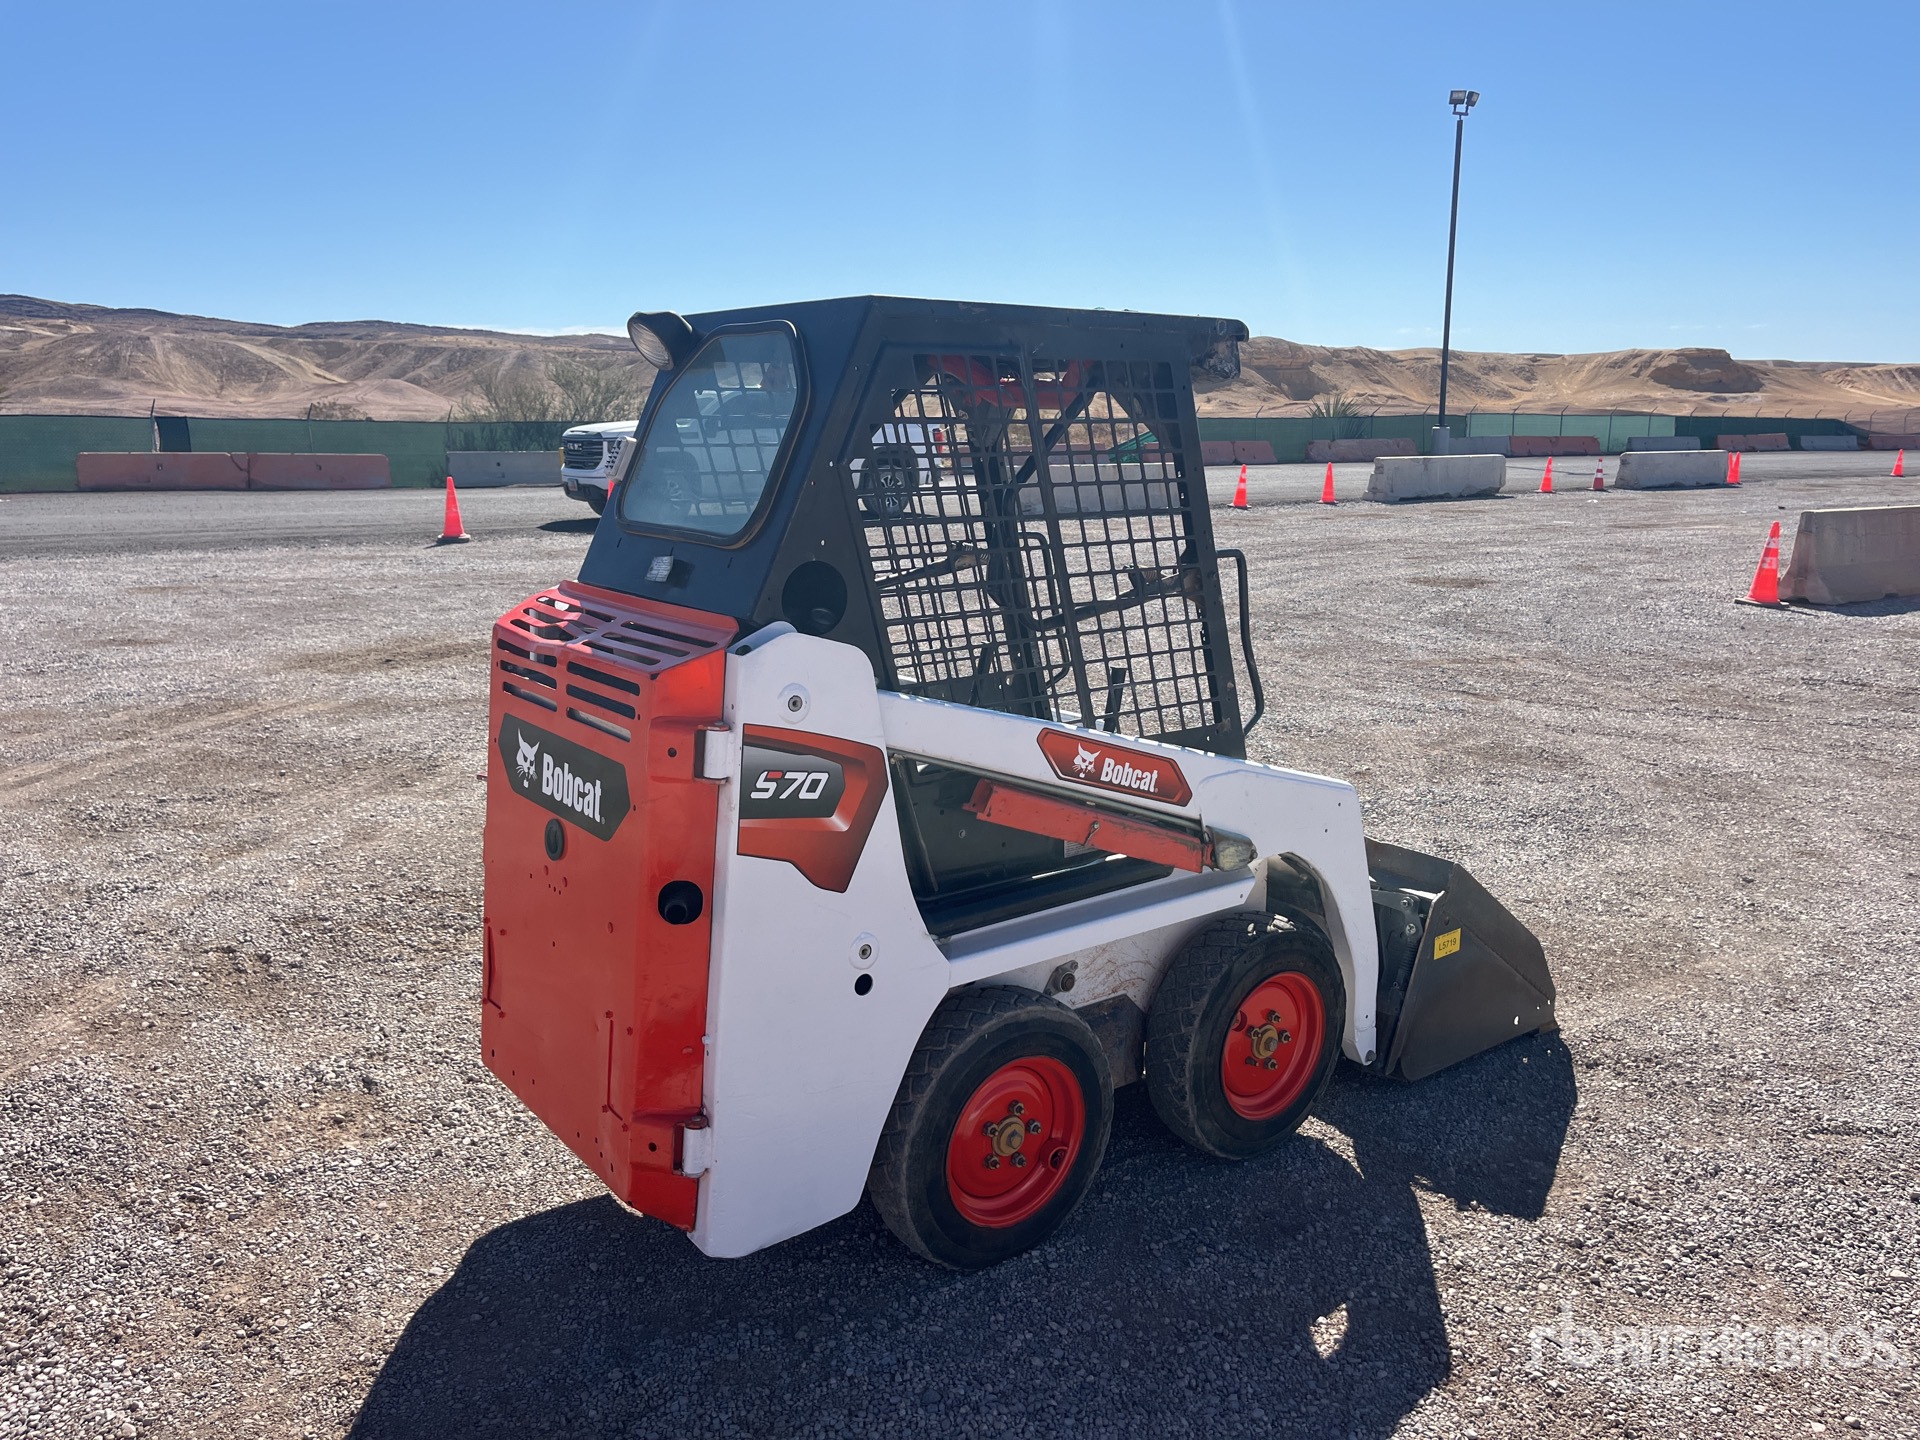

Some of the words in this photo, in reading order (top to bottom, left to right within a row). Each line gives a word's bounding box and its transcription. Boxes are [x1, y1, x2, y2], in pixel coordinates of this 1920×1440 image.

[542, 752, 602, 823] Bobcat
[750, 771, 829, 799] S70
[1100, 757, 1159, 793] Bobcat
[1438, 937, 1457, 951] L5719
